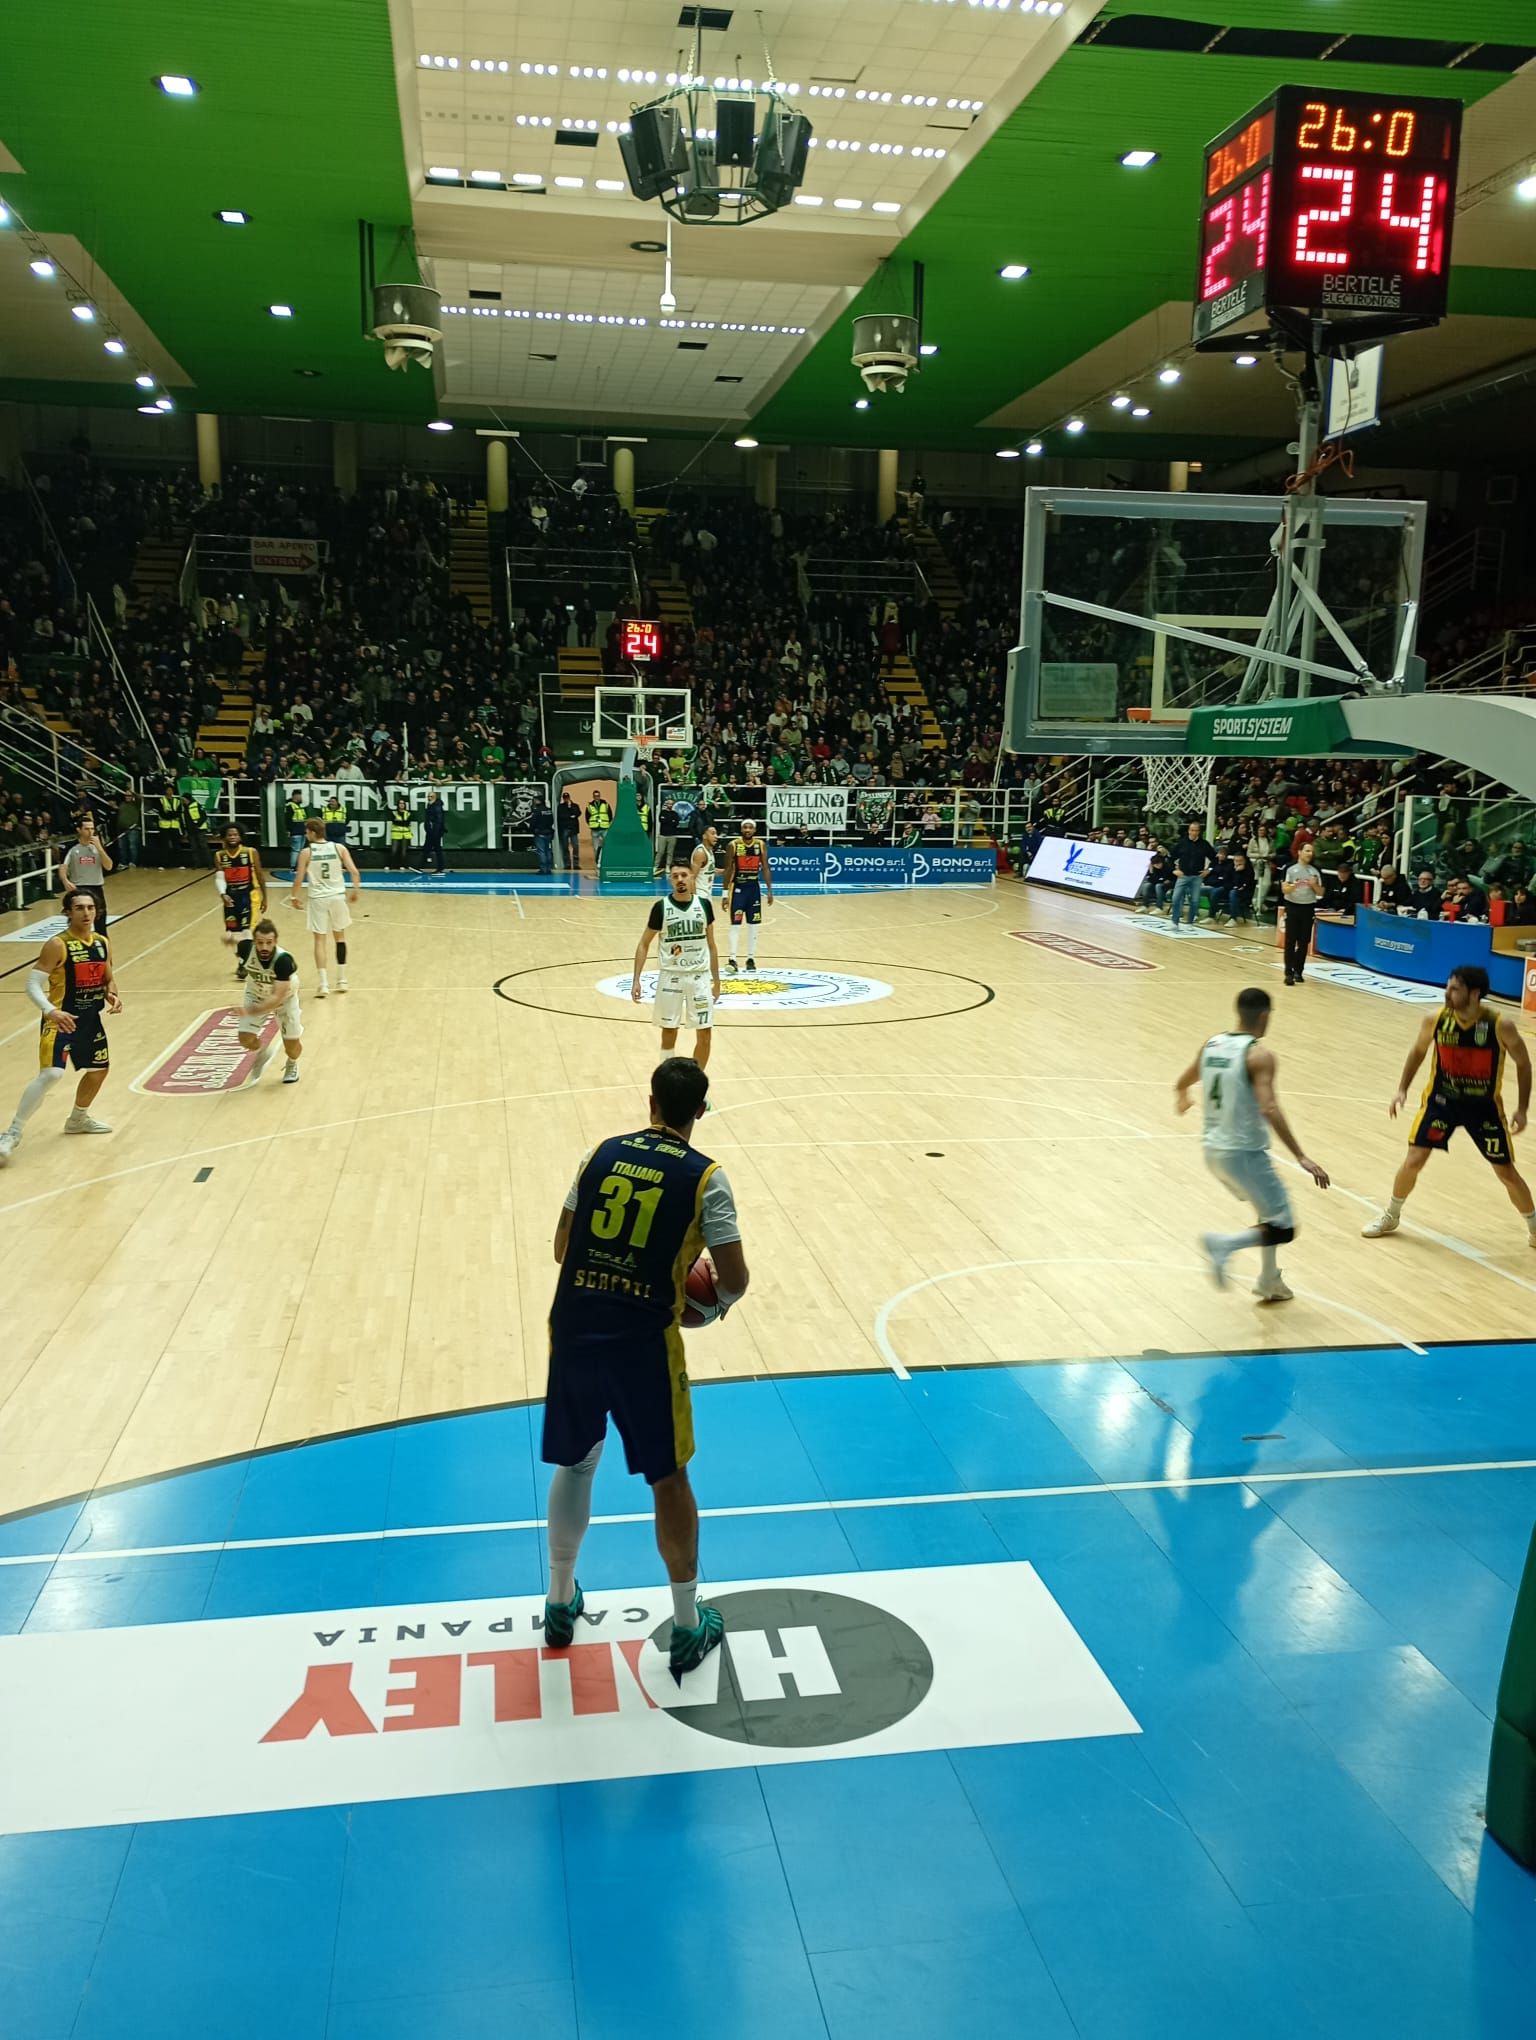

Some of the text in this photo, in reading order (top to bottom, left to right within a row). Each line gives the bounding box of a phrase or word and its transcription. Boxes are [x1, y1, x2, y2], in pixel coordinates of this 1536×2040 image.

[1299, 104, 1414, 156] 26:0
[1295, 166, 1436, 270] 24
[1203, 171, 1270, 299] 24
[1322, 292, 1400, 308] ELECTRONICS
[627, 623, 652, 634] 26:0
[627, 634, 657, 654] 24
[769, 811, 844, 825] CLUB ROMA
[768, 857, 800, 866] ONO
[845, 857, 885, 866] BONO
[932, 858, 972, 867] BONO
[321, 862, 330, 879] 2
[67, 940, 83, 951] 33
[697, 1011, 708, 1025] 77
[94, 1048, 108, 1062] 33
[162, 1053, 248, 1089] WEST
[1209, 1072, 1223, 1110] 4
[1485, 1138, 1499, 1153] 77
[612, 1161, 664, 1184] ITALIANO
[590, 1175, 664, 1249] 31
